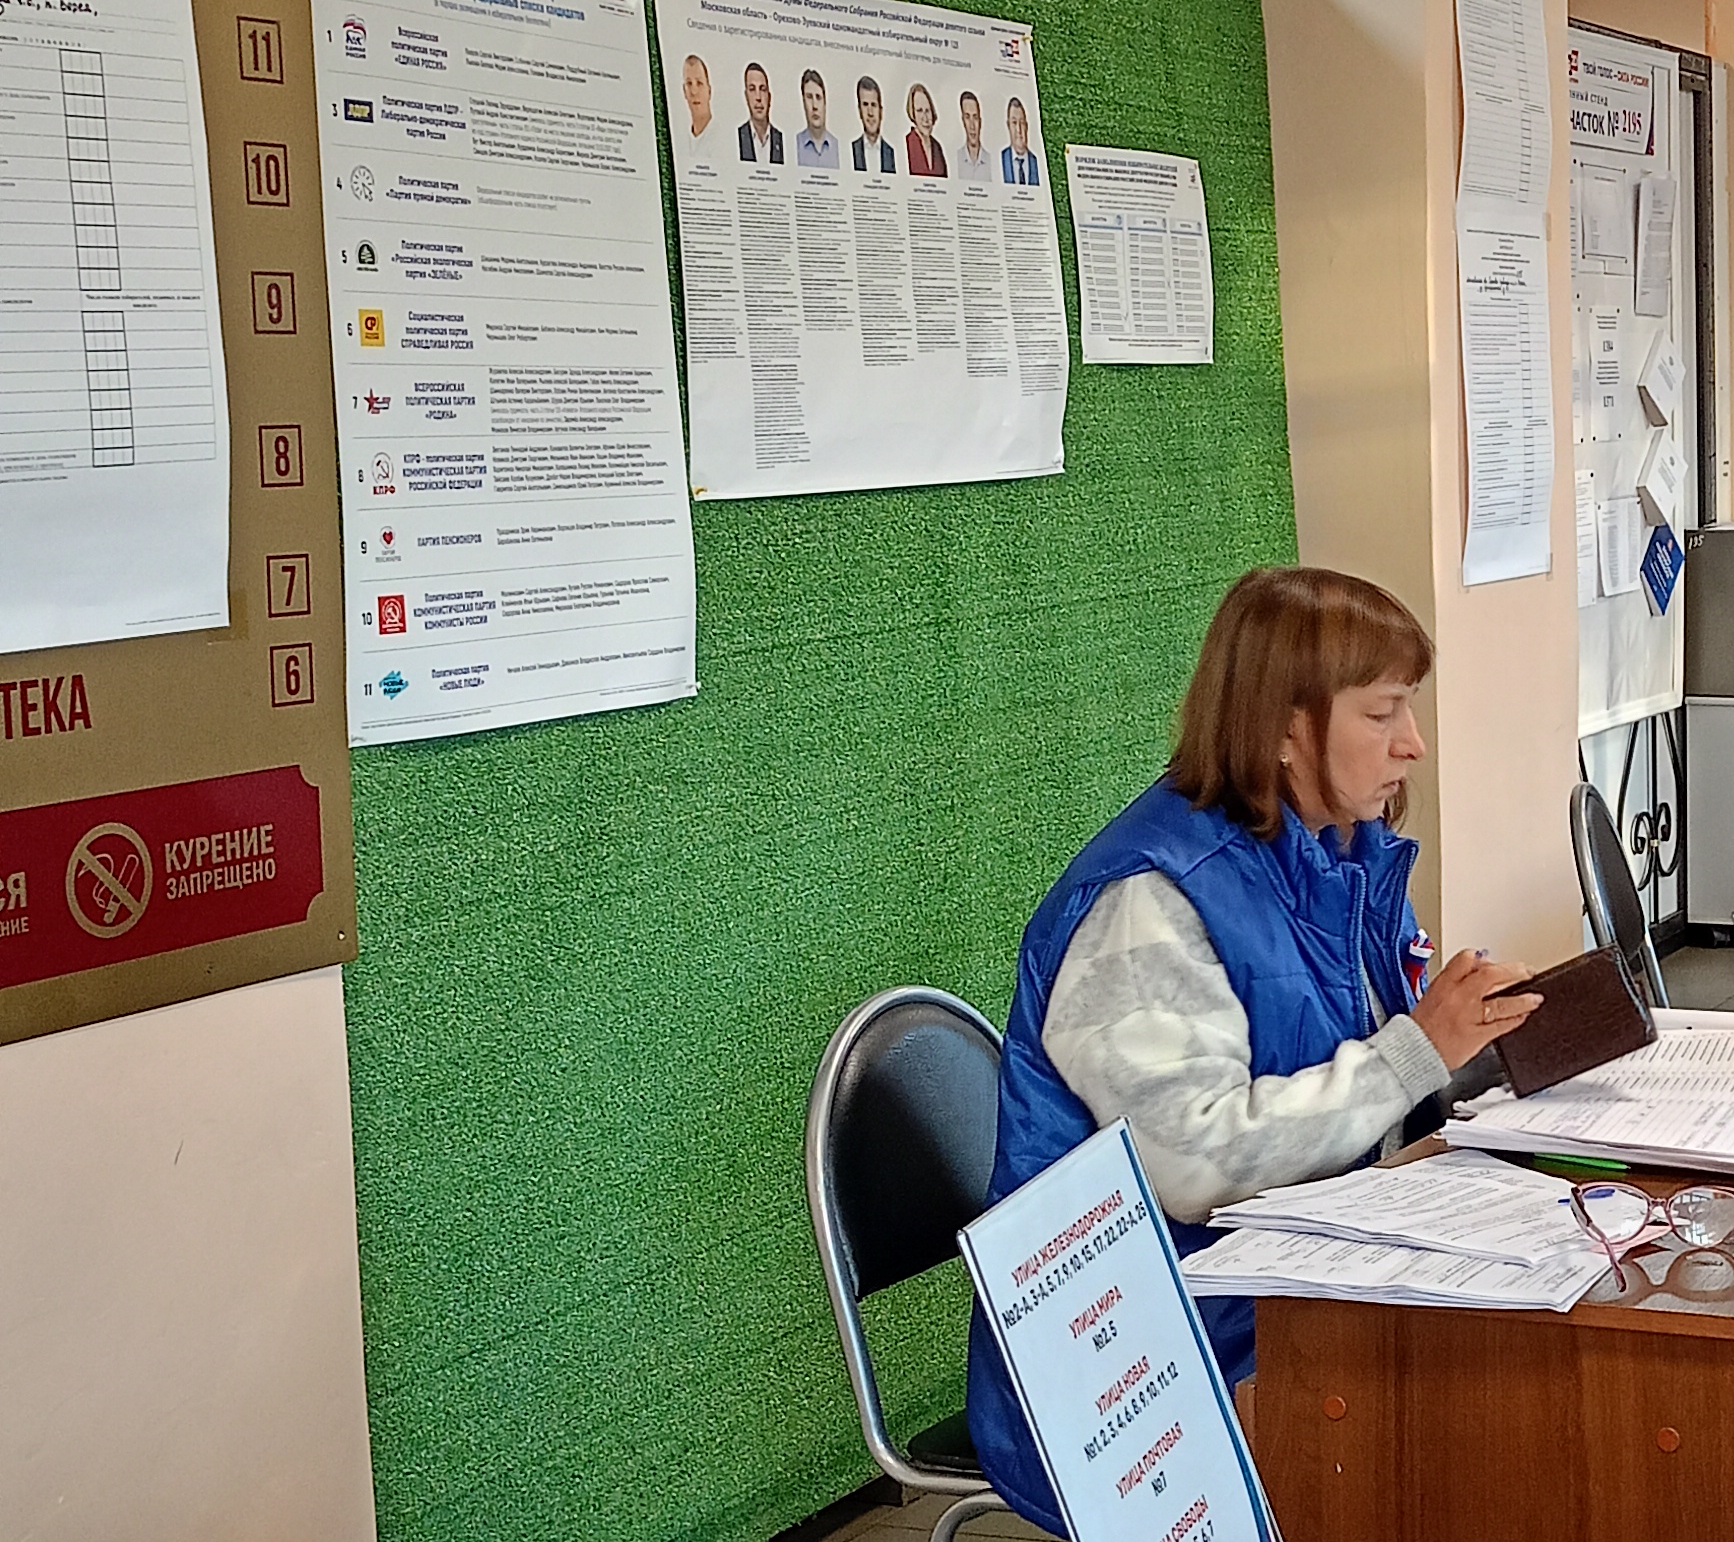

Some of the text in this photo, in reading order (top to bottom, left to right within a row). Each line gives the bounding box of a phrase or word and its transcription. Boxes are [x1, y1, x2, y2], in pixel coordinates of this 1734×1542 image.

[247, 29, 273, 75] 11
[1622, 109, 1642, 136] 2195
[251, 151, 282, 198] 10
[266, 281, 284, 326] 9
[274, 434, 291, 478] 8
[373, 485, 396, 496] КПРФ
[281, 565, 297, 608] 7
[362, 612, 373, 626] 10
[284, 653, 301, 697] 6
[364, 683, 373, 696] 11
[0, 674, 92, 741] ТЕКА
[164, 823, 276, 873] КУРЕНИЕ
[165, 857, 277, 902] ЗАПРЕЩЕНО
[1011, 1189, 1125, 1288] УЛИЦА ЖЕЛЕЗНОДОРОЖНАЯ
[1068, 1285, 1123, 1339] УЛИЦА МИРА
[1095, 1355, 1151, 1416] УЛИЦА НОВАЯ
[1167, 1361, 1179, 1380] 12
[1115, 1421, 1184, 1500] УЛИЦА ПОЧТОВАЯ
[1151, 1470, 1168, 1497] №7
